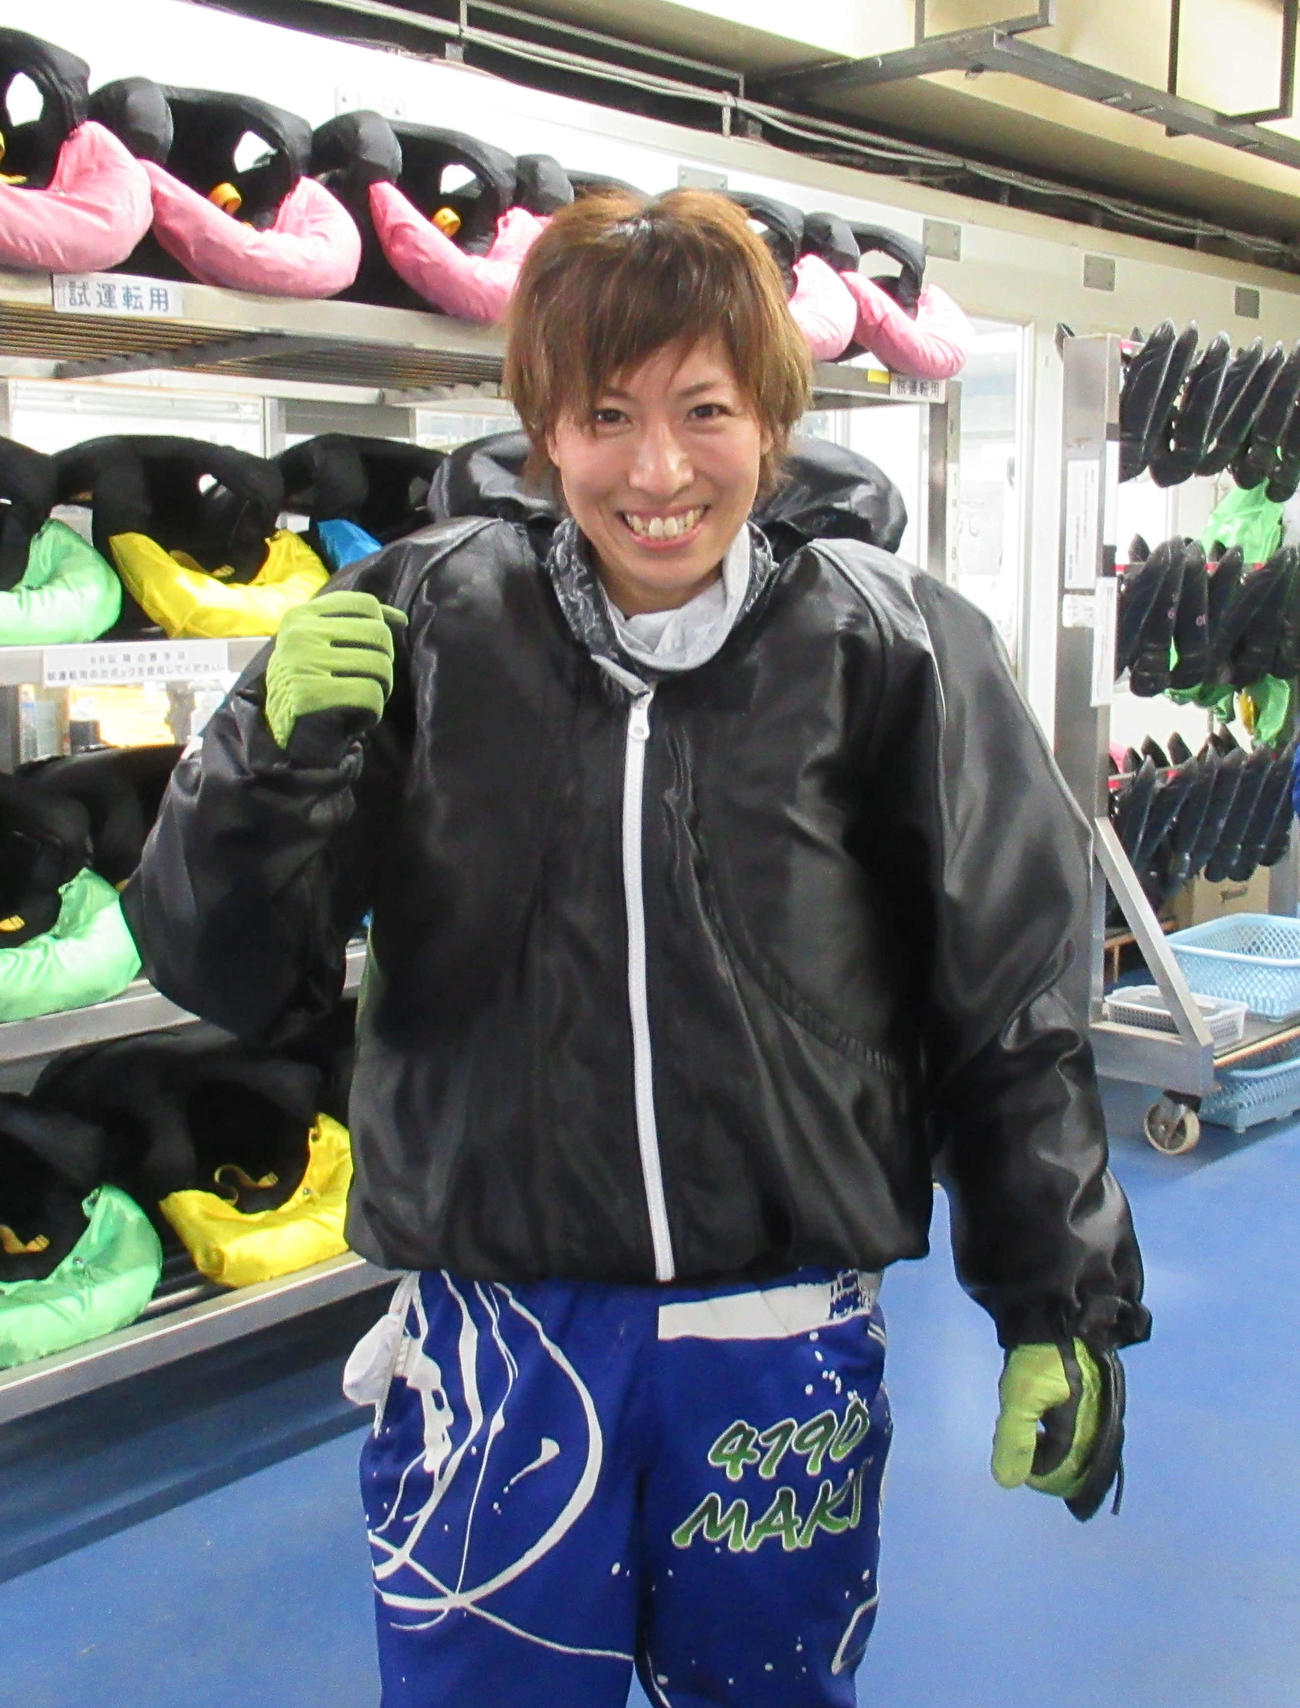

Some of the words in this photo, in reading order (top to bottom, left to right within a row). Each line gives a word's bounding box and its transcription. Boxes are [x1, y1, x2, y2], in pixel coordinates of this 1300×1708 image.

[67, 280, 169, 313] 試運転用
[671, 1470, 864, 1552] MAKI
